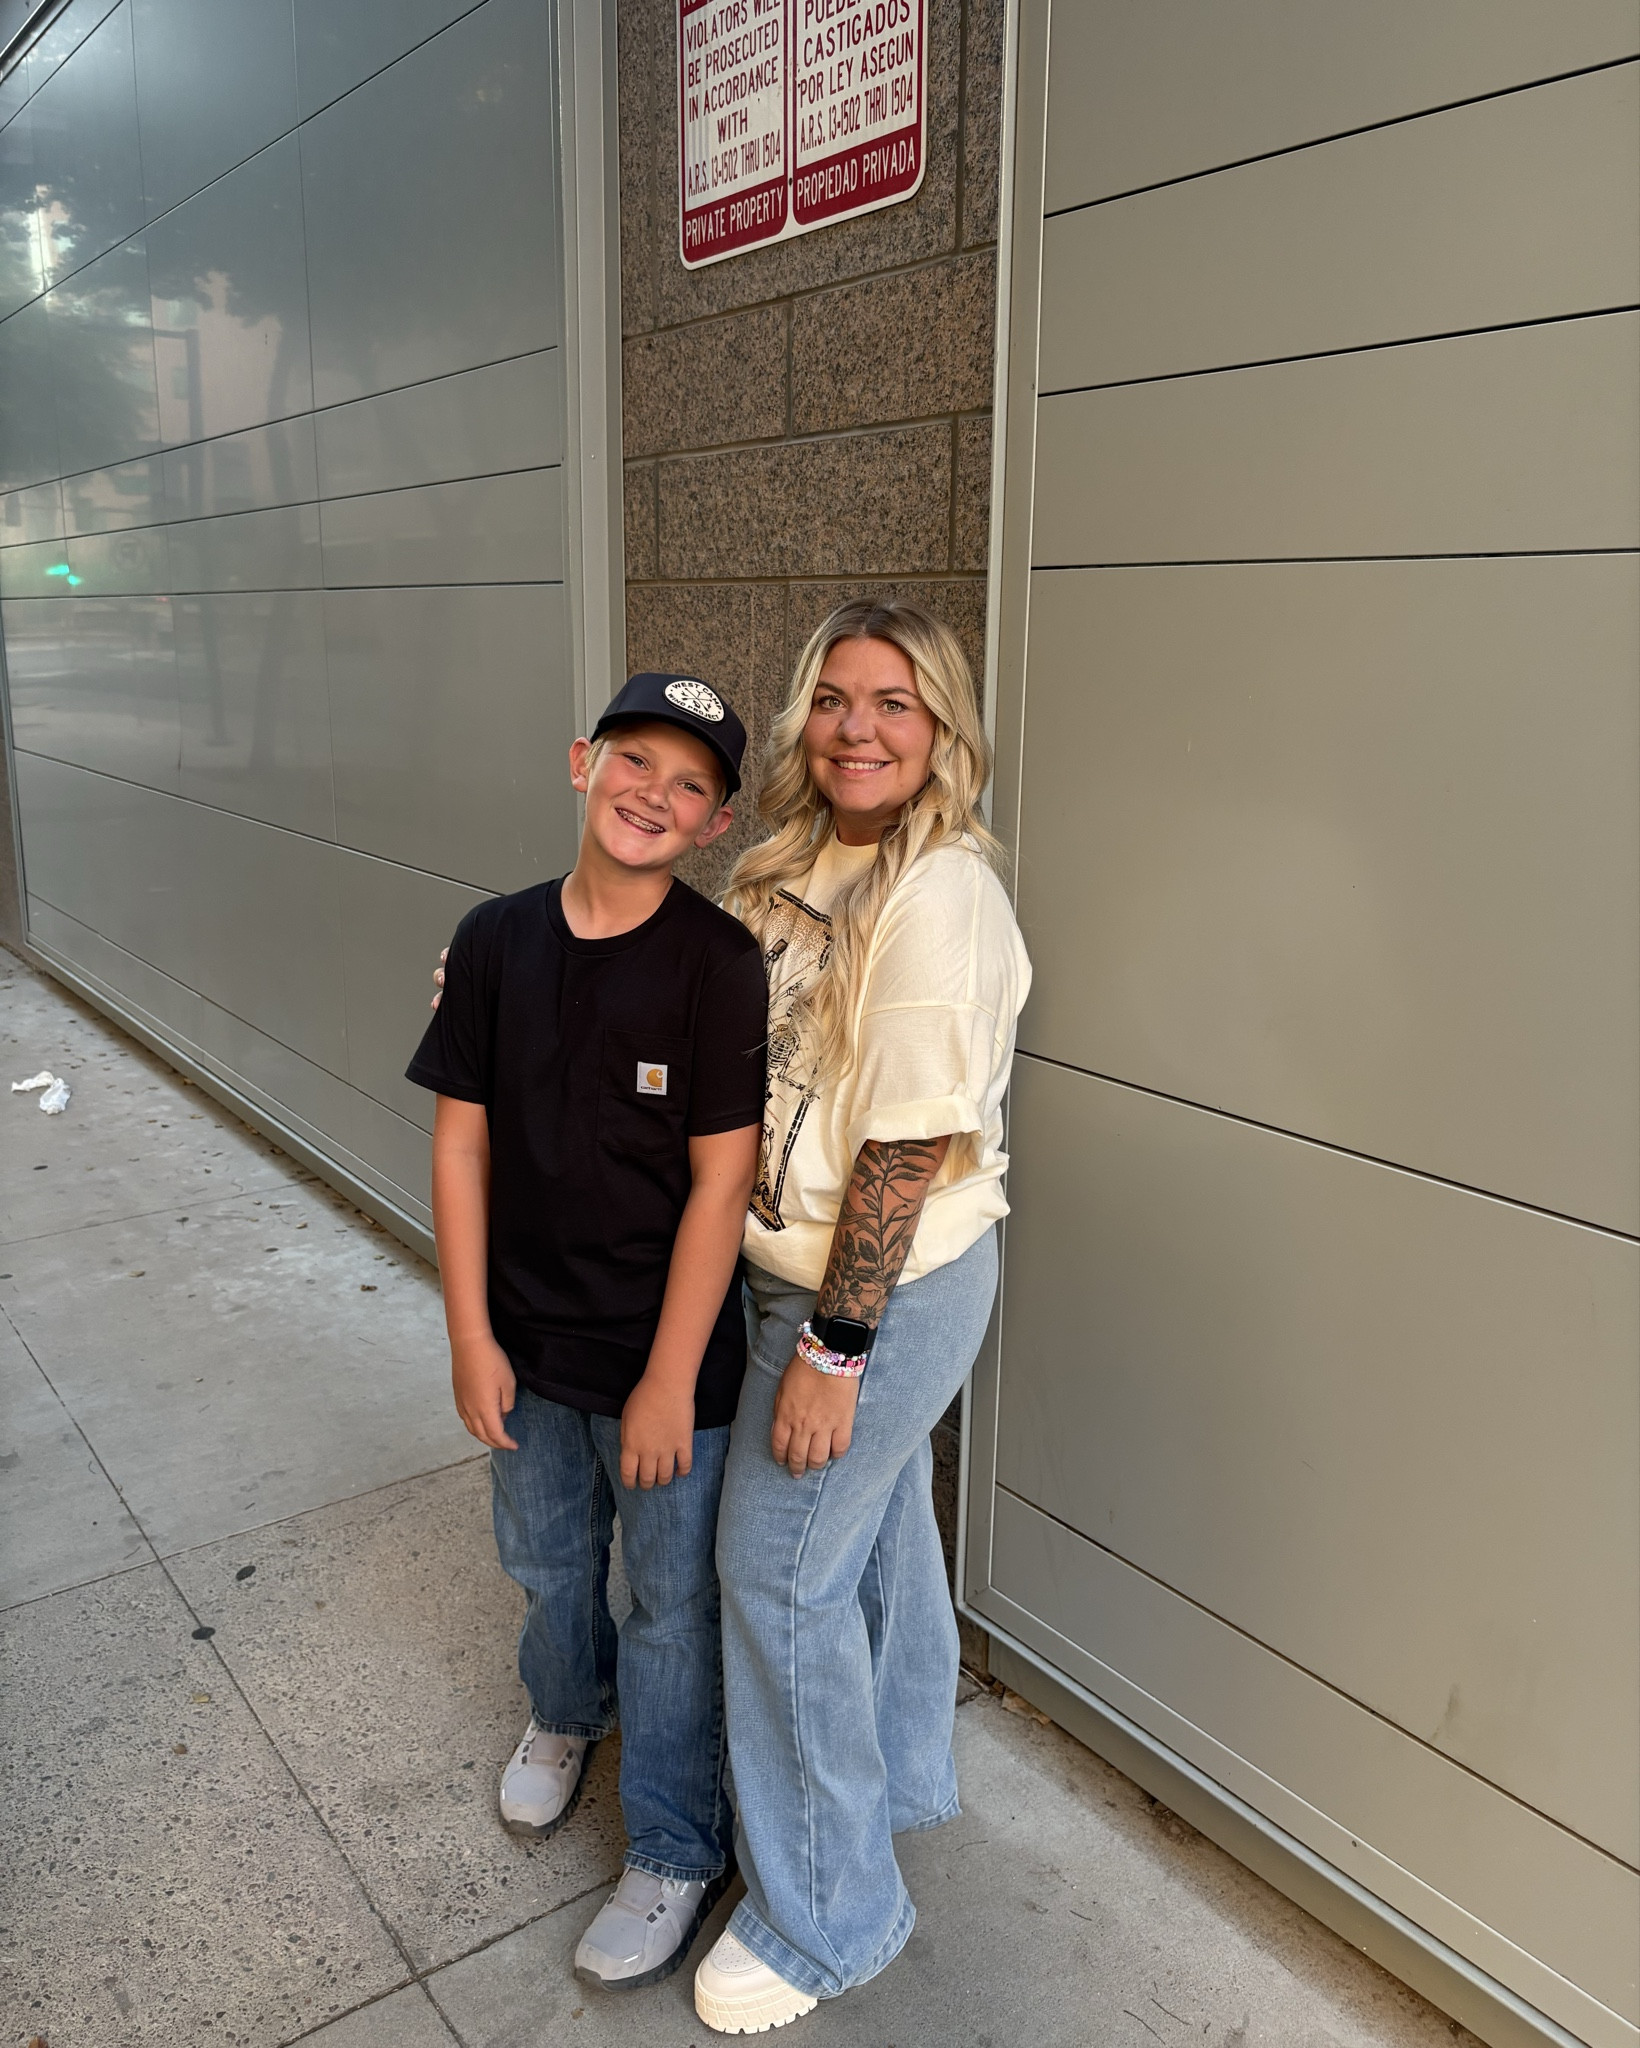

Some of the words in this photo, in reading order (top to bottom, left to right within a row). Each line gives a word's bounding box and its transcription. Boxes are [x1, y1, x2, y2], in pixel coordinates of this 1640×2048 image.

[686, 0, 748, 53] VIOLATORS
[753, 0, 781, 18] WI
[688, 57, 701, 88] BE
[705, 18, 779, 79] PROSECUTED
[803, 0, 910, 67] CASTIGADOS
[689, 94, 699, 122] IN
[703, 55, 778, 116] ACCORDANCE
[800, 71, 824, 108] POR
[829, 57, 854, 95] LEY
[860, 28, 914, 82] ASEGUN
[717, 106, 748, 144] WITH
[800, 110, 826, 152] A.R.S.
[829, 94, 860, 141] 13-1502
[864, 83, 887, 127] THRU
[891, 71, 913, 116] 1504
[688, 160, 709, 197] A.R.S.
[711, 146, 738, 188] 13-1502
[741, 137, 760, 176] THRU
[762, 128, 781, 168] 1504
[796, 158, 858, 211] PROPIEDAD
[862, 136, 915, 187] PRIVADA
[685, 207, 726, 249] PRIVATE
[730, 185, 784, 234] PROPERTY
